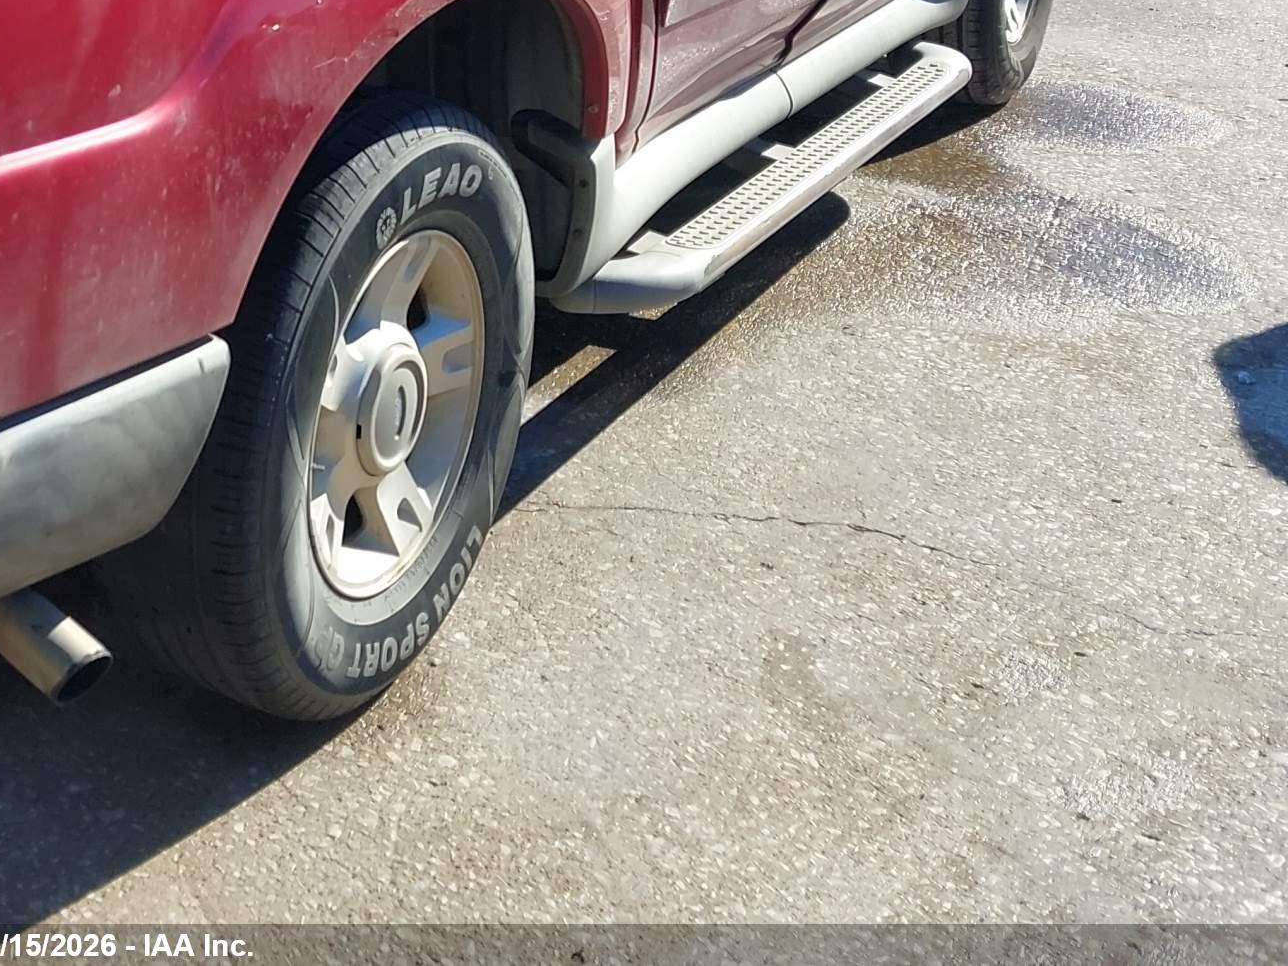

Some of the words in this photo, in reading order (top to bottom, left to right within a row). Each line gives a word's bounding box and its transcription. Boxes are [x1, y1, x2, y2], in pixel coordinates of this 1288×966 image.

[400, 162, 482, 226] LEAO
[433, 525, 483, 624] LION
[345, 612, 430, 678] SPORT
